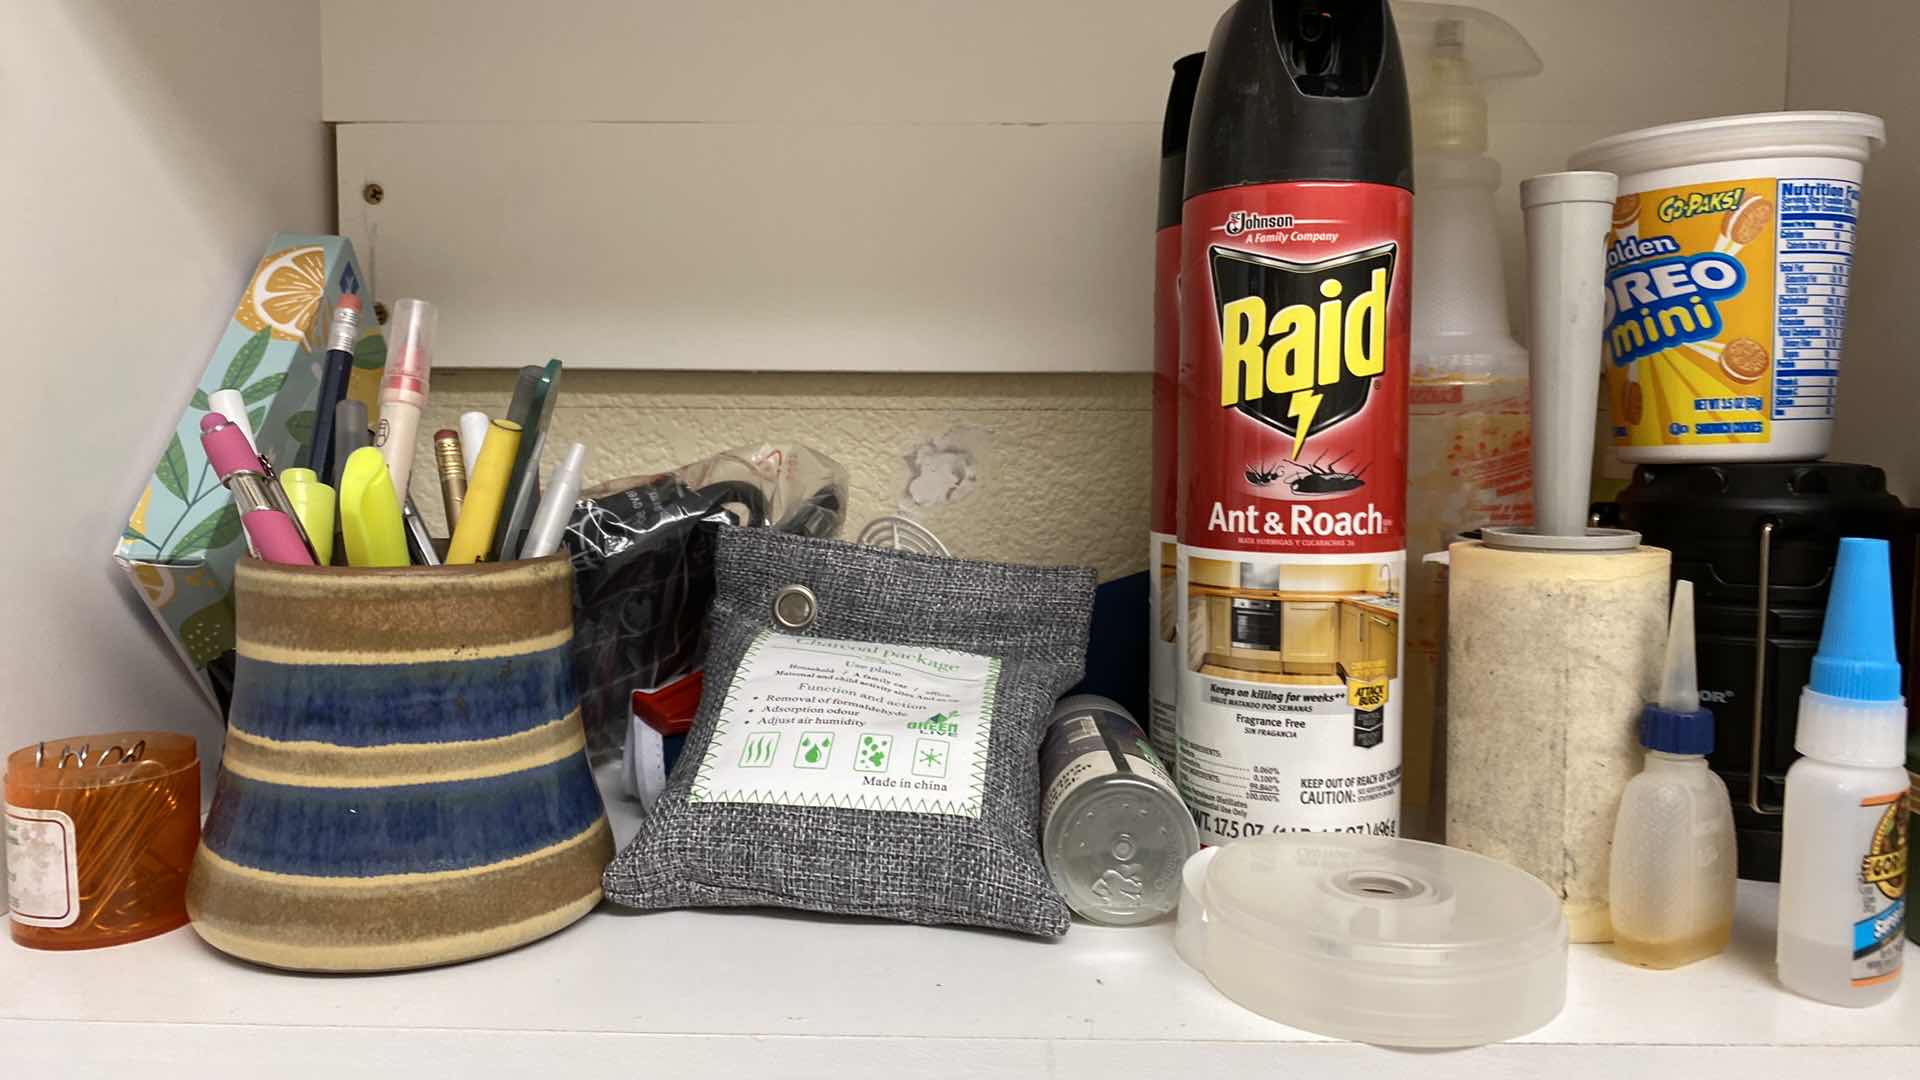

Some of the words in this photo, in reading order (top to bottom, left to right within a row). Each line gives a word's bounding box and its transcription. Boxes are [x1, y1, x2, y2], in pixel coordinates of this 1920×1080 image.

[1781, 183, 1843, 197] Nutrition
[1226, 212, 1293, 234] Johnson
[1246, 234, 1253, 244] A
[1255, 231, 1288, 244] Family
[1290, 231, 1339, 244] Company
[1604, 237, 1678, 267] olden
[1611, 295, 1713, 357] mini
[1221, 268, 1387, 408] Raid
[1208, 502, 1259, 534] Ant
[1263, 511, 1287, 536] &
[1290, 503, 1383, 537] Roach
[795, 637, 878, 655] Charcoal
[883, 647, 961, 674] package
[845, 659, 868, 670] Use
[775, 669, 816, 680] Maternal
[816, 673, 834, 681] and
[835, 675, 858, 685] child
[859, 680, 892, 694] activity
[789, 663, 835, 674] Household
[863, 674, 892, 686] family
[894, 682, 909, 690] car
[798, 682, 857, 698] Function
[860, 692, 884, 704] and
[887, 700, 927, 712] action
[1210, 683, 1236, 697] Keeps
[1237, 688, 1250, 698] on
[1251, 688, 1284, 704] killing
[1285, 691, 1302, 704] for
[760, 704, 825, 716] Adsorption
[826, 707, 861, 718] odour
[765, 694, 816, 704] Removal
[818, 696, 831, 705] of
[831, 697, 909, 718] formaldehyde
[1262, 702, 1277, 711] POR
[1278, 704, 1313, 713] SEMANAS
[757, 715, 796, 728] Adjust
[798, 717, 814, 725] air
[815, 717, 866, 729] humidity
[1236, 713, 1282, 727] Fragrance
[1285, 718, 1306, 729] Free
[1245, 727, 1257, 735] SIN
[1258, 729, 1297, 739] FRAGANCIA
[862, 775, 897, 789] Made
[900, 778, 911, 789] in
[914, 778, 949, 793] china
[1300, 777, 1324, 789] KEEP
[1325, 777, 1343, 789] OUT
[1345, 777, 1356, 788] OF
[1357, 773, 1378, 787] REACH
[1299, 790, 1357, 805] CAUTION:
[1232, 808, 1248, 819] Only
[1213, 817, 1240, 839] 17.5
